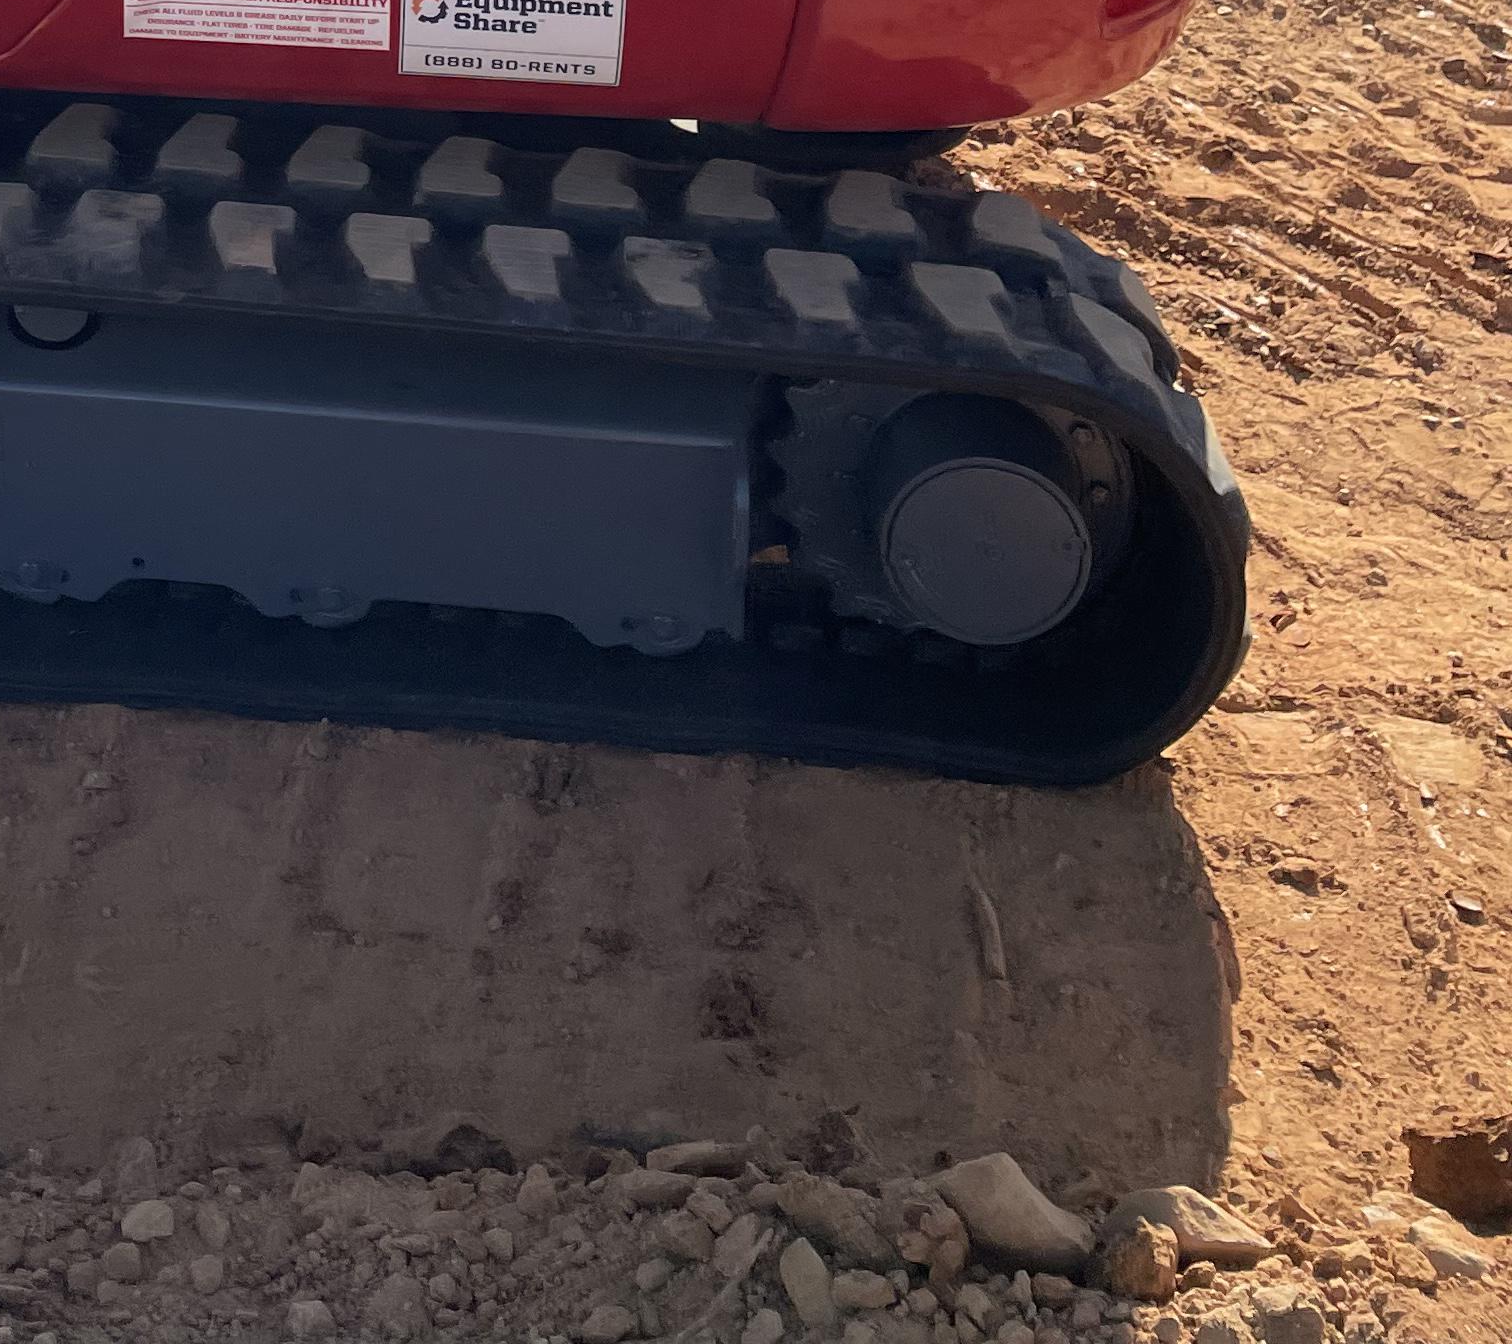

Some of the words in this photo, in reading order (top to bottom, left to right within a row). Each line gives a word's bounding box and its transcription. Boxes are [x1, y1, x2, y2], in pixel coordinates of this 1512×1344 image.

[163, 7, 176, 16] ALL
[178, 8, 203, 16] FLUID
[278, 13, 304, 23] DAILY
[305, 15, 337, 24] BEFORE
[201, 20, 222, 28] FLAT
[453, 12, 538, 34] Share
[424, 53, 483, 70] (888)
[491, 58, 597, 76] 80-RENTS
